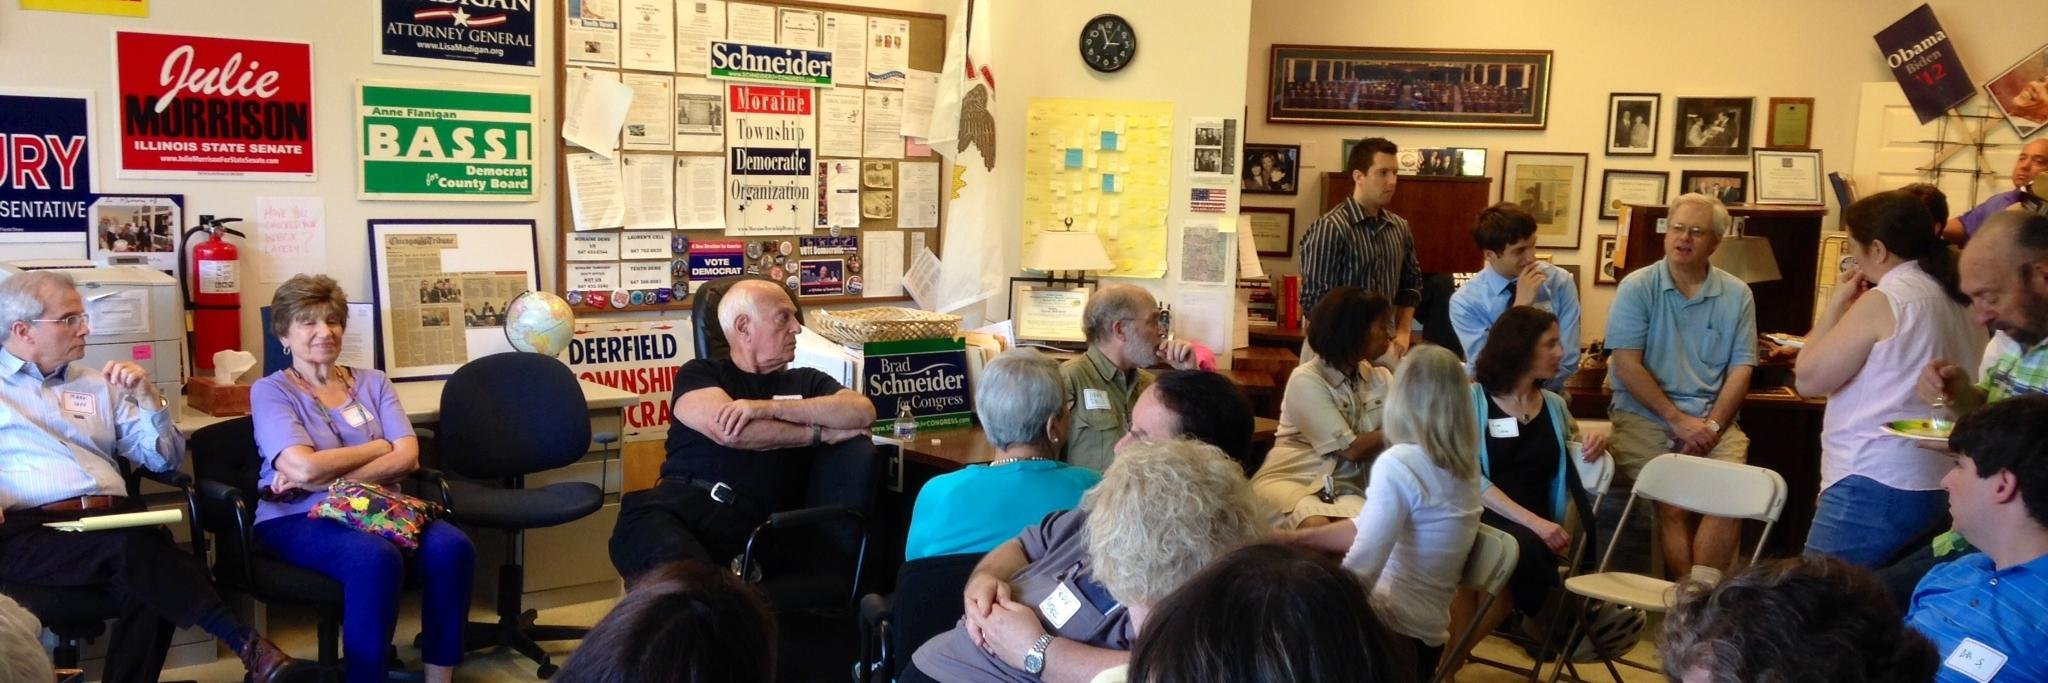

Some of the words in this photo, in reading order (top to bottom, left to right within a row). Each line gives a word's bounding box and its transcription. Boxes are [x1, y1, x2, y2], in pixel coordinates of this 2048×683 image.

[386, 22, 466, 40] ATTORNEY
[468, 29, 532, 47] GENERAL
[417, 41, 504, 57] www.LisaMadigan.org
[712, 43, 832, 78] Schneider
[1888, 30, 1947, 68] Obama
[1905, 51, 1942, 74] Biden
[1914, 63, 1948, 86] '12
[155, 45, 280, 113] Julie
[738, 88, 806, 113] Moraine
[125, 95, 308, 142] MORRISON
[372, 107, 404, 117] Anne
[406, 109, 458, 121] Flanigan
[368, 124, 529, 160] BASSI
[736, 118, 805, 142] Township
[134, 140, 198, 153] ILLINOIS
[201, 143, 246, 154] STATE
[249, 145, 303, 155] SENATE
[160, 155, 280, 165] www.JulieMorrisonForStateSenate.com
[466, 165, 529, 178] Democrat
[736, 148, 807, 172] Democratic
[425, 172, 440, 187] for
[438, 177, 488, 192] County
[490, 179, 529, 190] Board
[732, 179, 810, 207] Organization
[0, 200, 87, 218] SENTATIVE
[692, 267, 742, 276] DEMOCRAT
[704, 258, 730, 266] VOTE
[569, 333, 677, 365] DEERFIELD
[881, 356, 911, 374] Brad
[577, 366, 682, 395] WNSHI
[870, 369, 964, 397] Schneider
[624, 399, 672, 429] CRA
[895, 396, 910, 416] for
[911, 394, 964, 412] Congress
